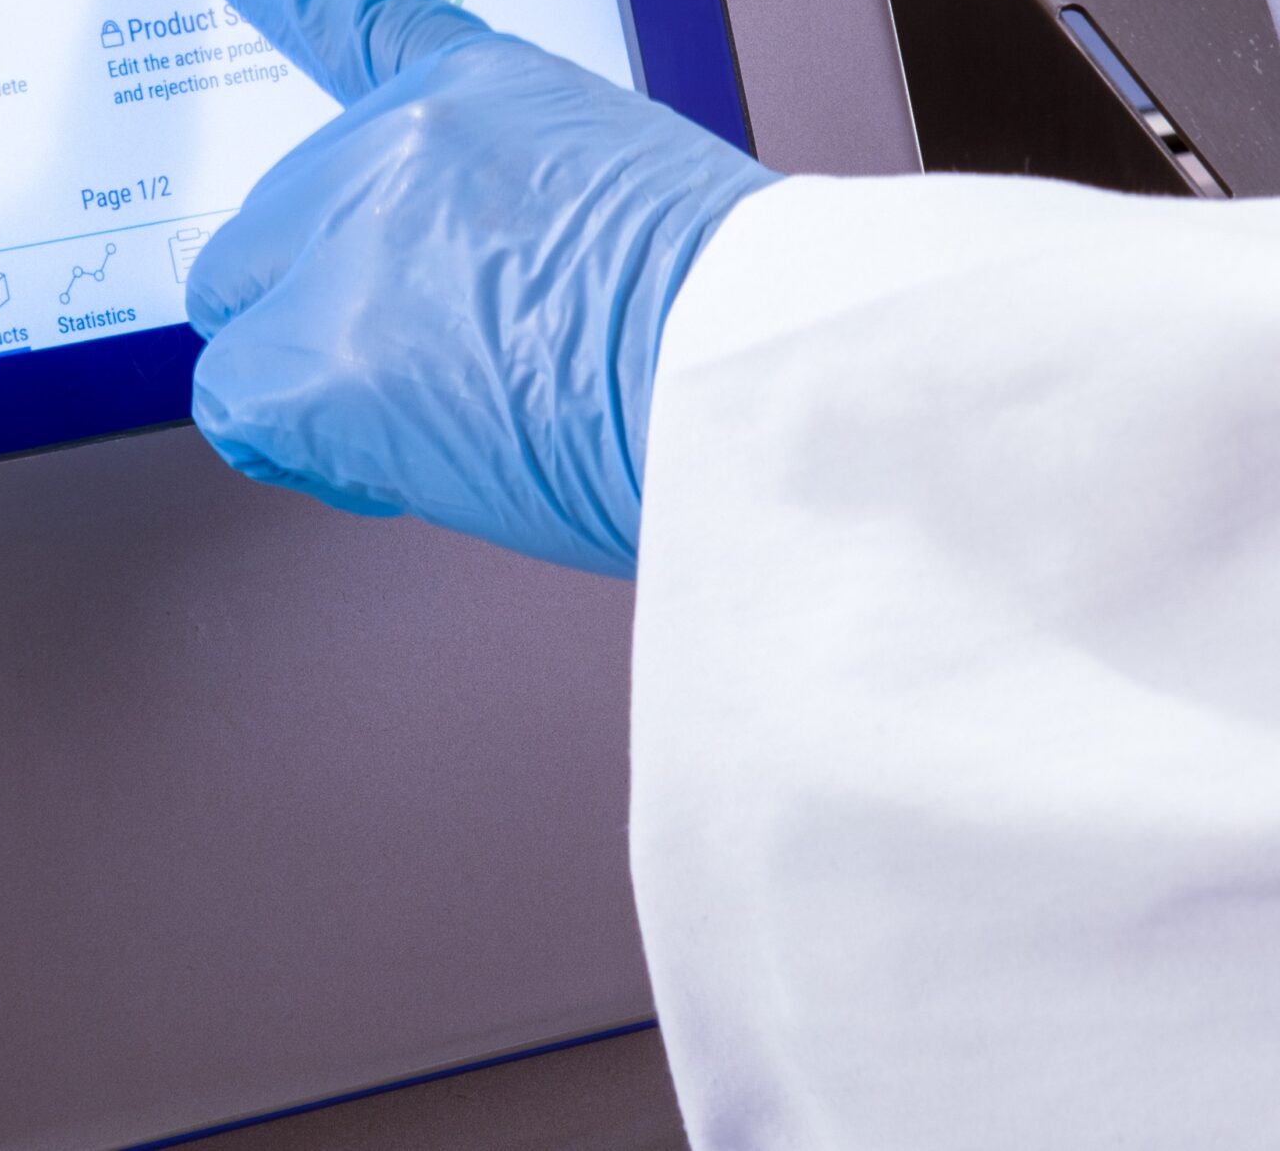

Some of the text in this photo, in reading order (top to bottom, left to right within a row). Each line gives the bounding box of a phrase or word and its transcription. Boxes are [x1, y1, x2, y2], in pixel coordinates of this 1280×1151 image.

[127, 7, 218, 42] Product
[107, 57, 141, 79] Edit
[143, 52, 171, 73] the
[174, 44, 224, 68] active
[113, 62, 290, 105] and rejection settings
[81, 175, 173, 212] Page 1/2
[57, 305, 137, 335] Statistics
